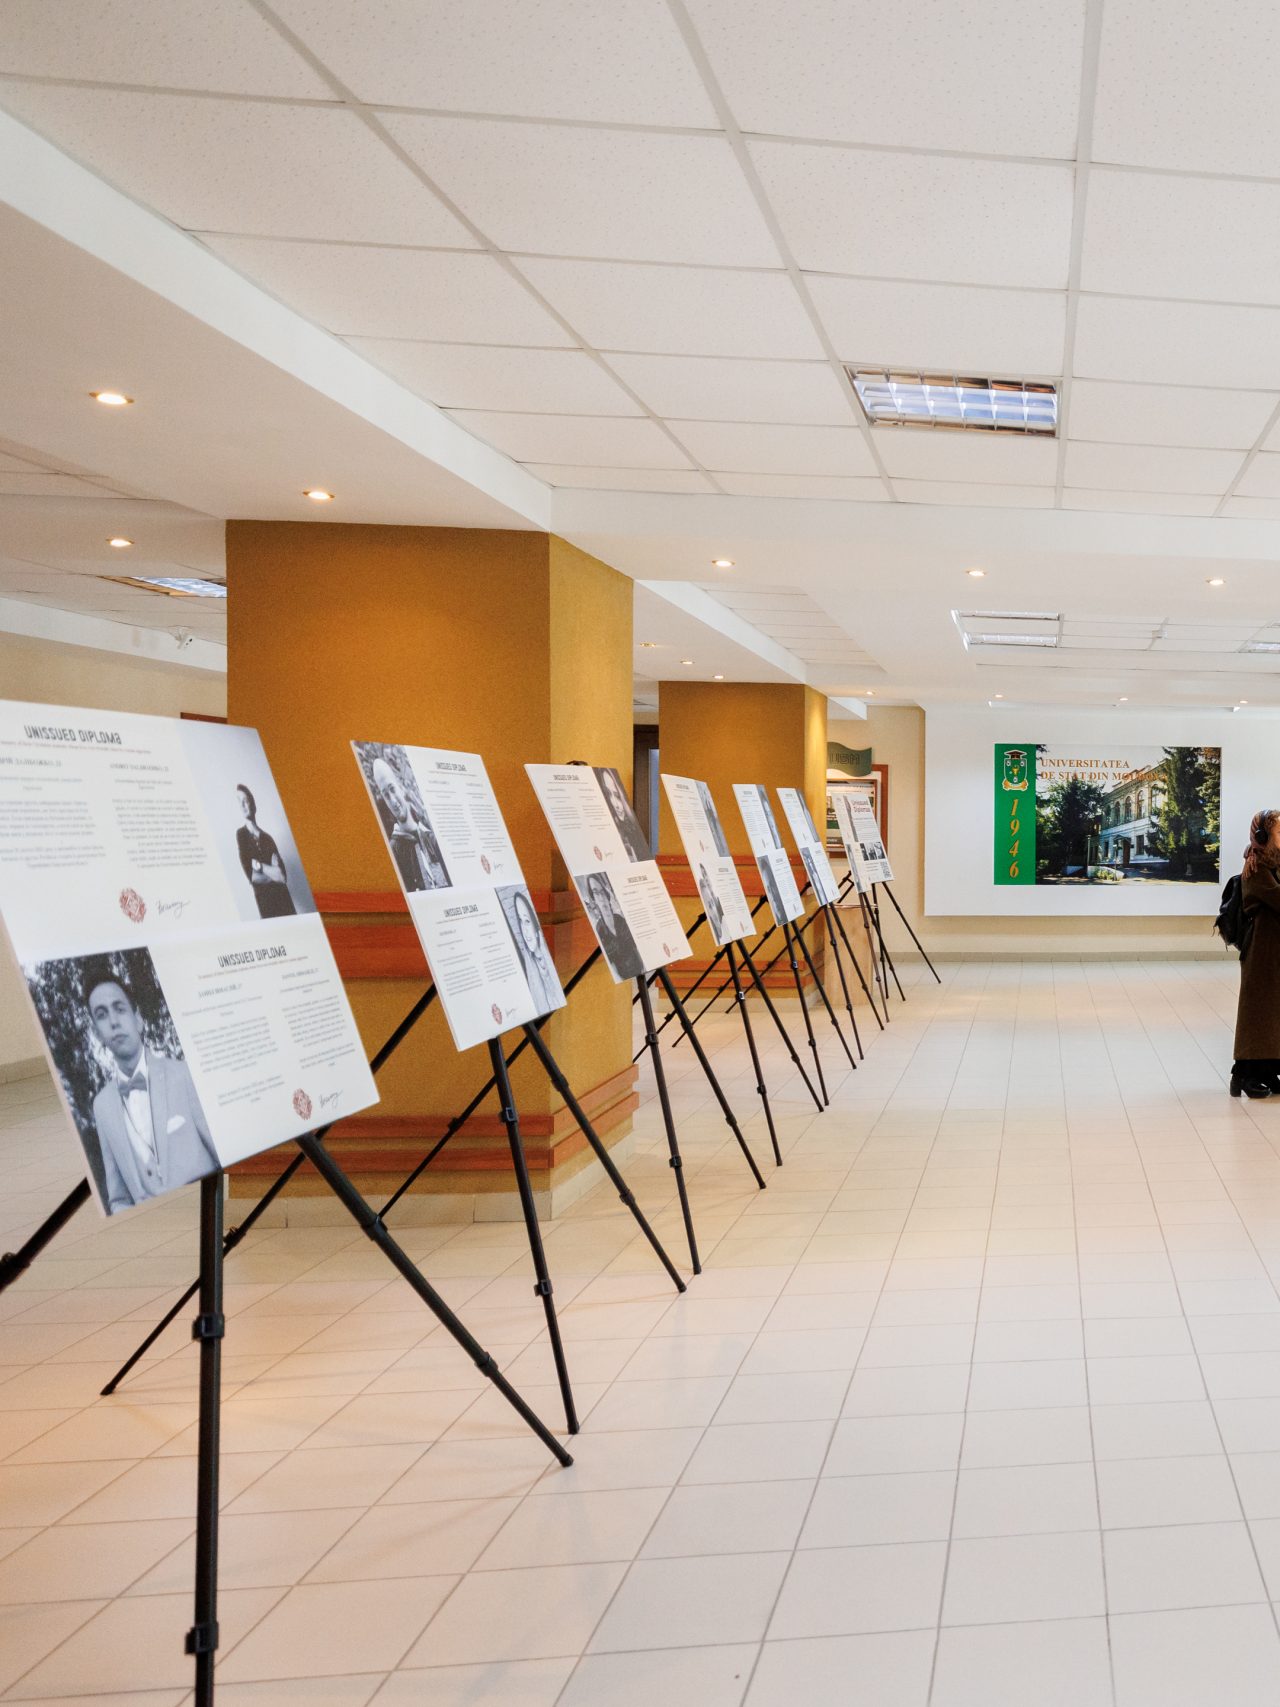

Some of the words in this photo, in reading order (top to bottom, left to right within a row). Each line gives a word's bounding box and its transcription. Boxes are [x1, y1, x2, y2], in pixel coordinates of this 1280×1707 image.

[24, 725, 76, 741] UNISSUED
[1041, 758, 1130, 769] UNIVERSITATEA
[1041, 771, 1053, 780] DE
[1058, 771, 1086, 780] STAT
[1088, 772, 1109, 781] DIN
[1008, 798, 1021, 879] 1946
[217, 950, 255, 968] UNISSUED
